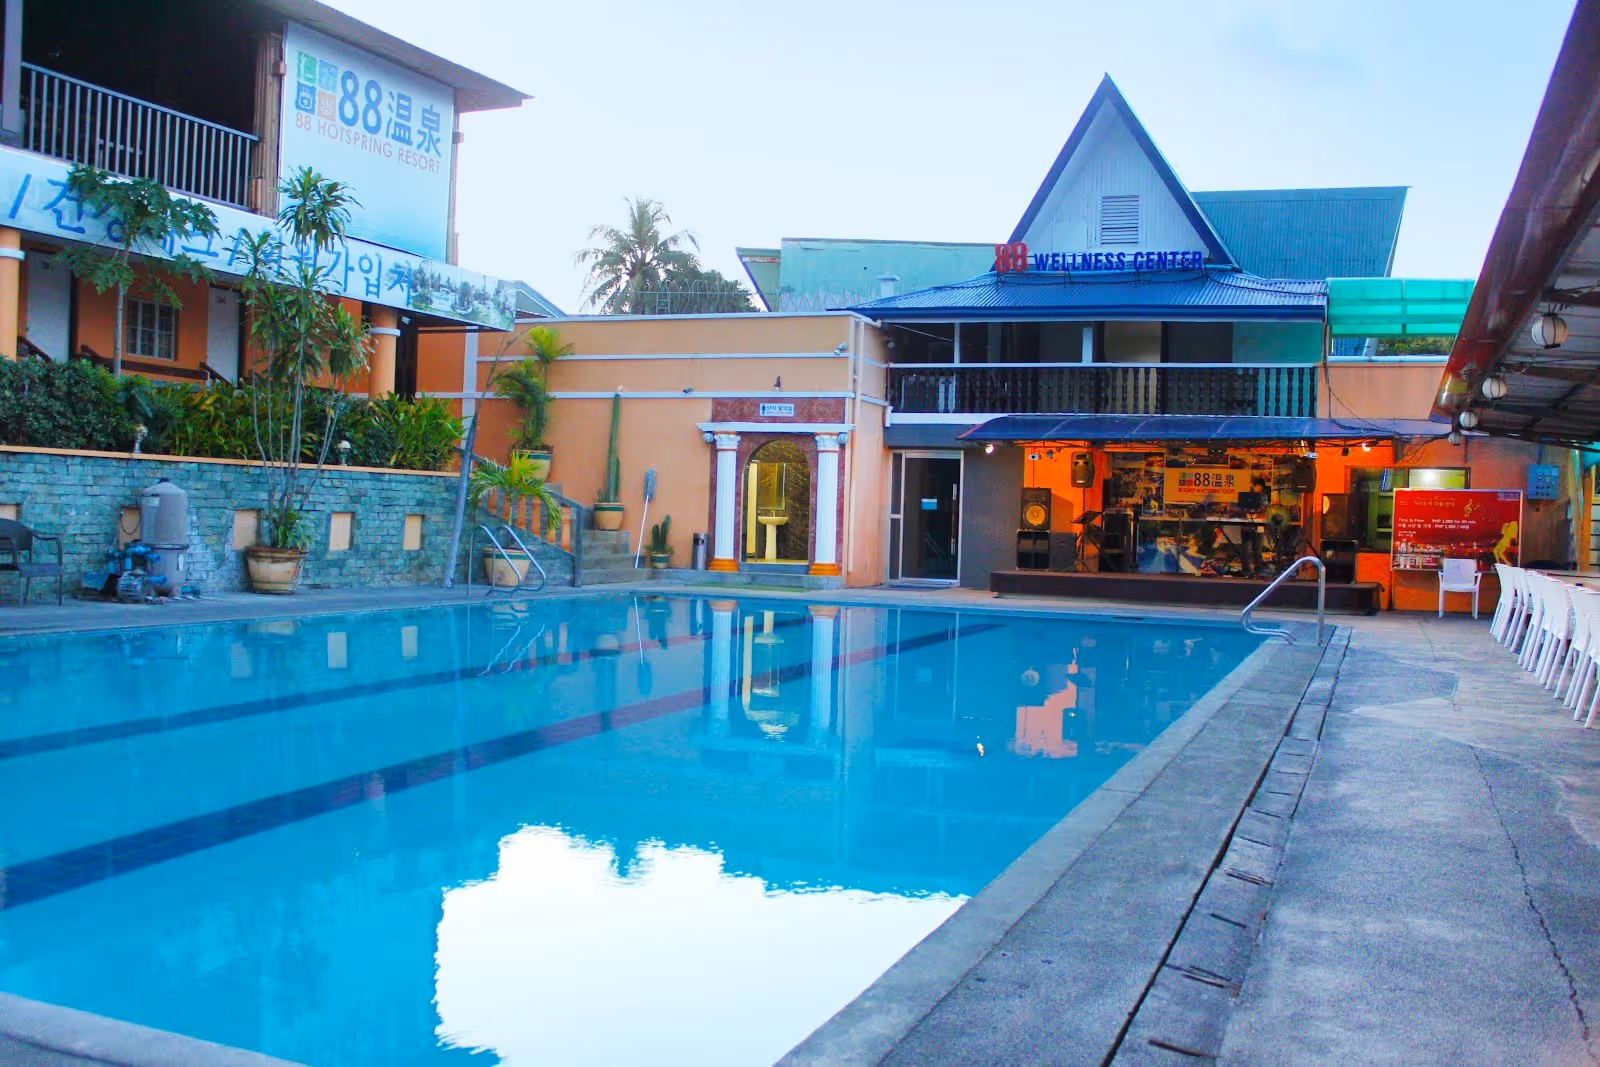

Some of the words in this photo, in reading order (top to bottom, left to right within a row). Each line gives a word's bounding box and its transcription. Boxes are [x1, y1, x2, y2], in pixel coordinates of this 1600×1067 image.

[295, 112, 312, 132] 88
[317, 119, 393, 159] HOTSPRING
[398, 147, 441, 175] RESORT
[995, 242, 1028, 273] 88
[1034, 251, 1126, 271] WELLNESS
[1133, 251, 1203, 270] CENTER
